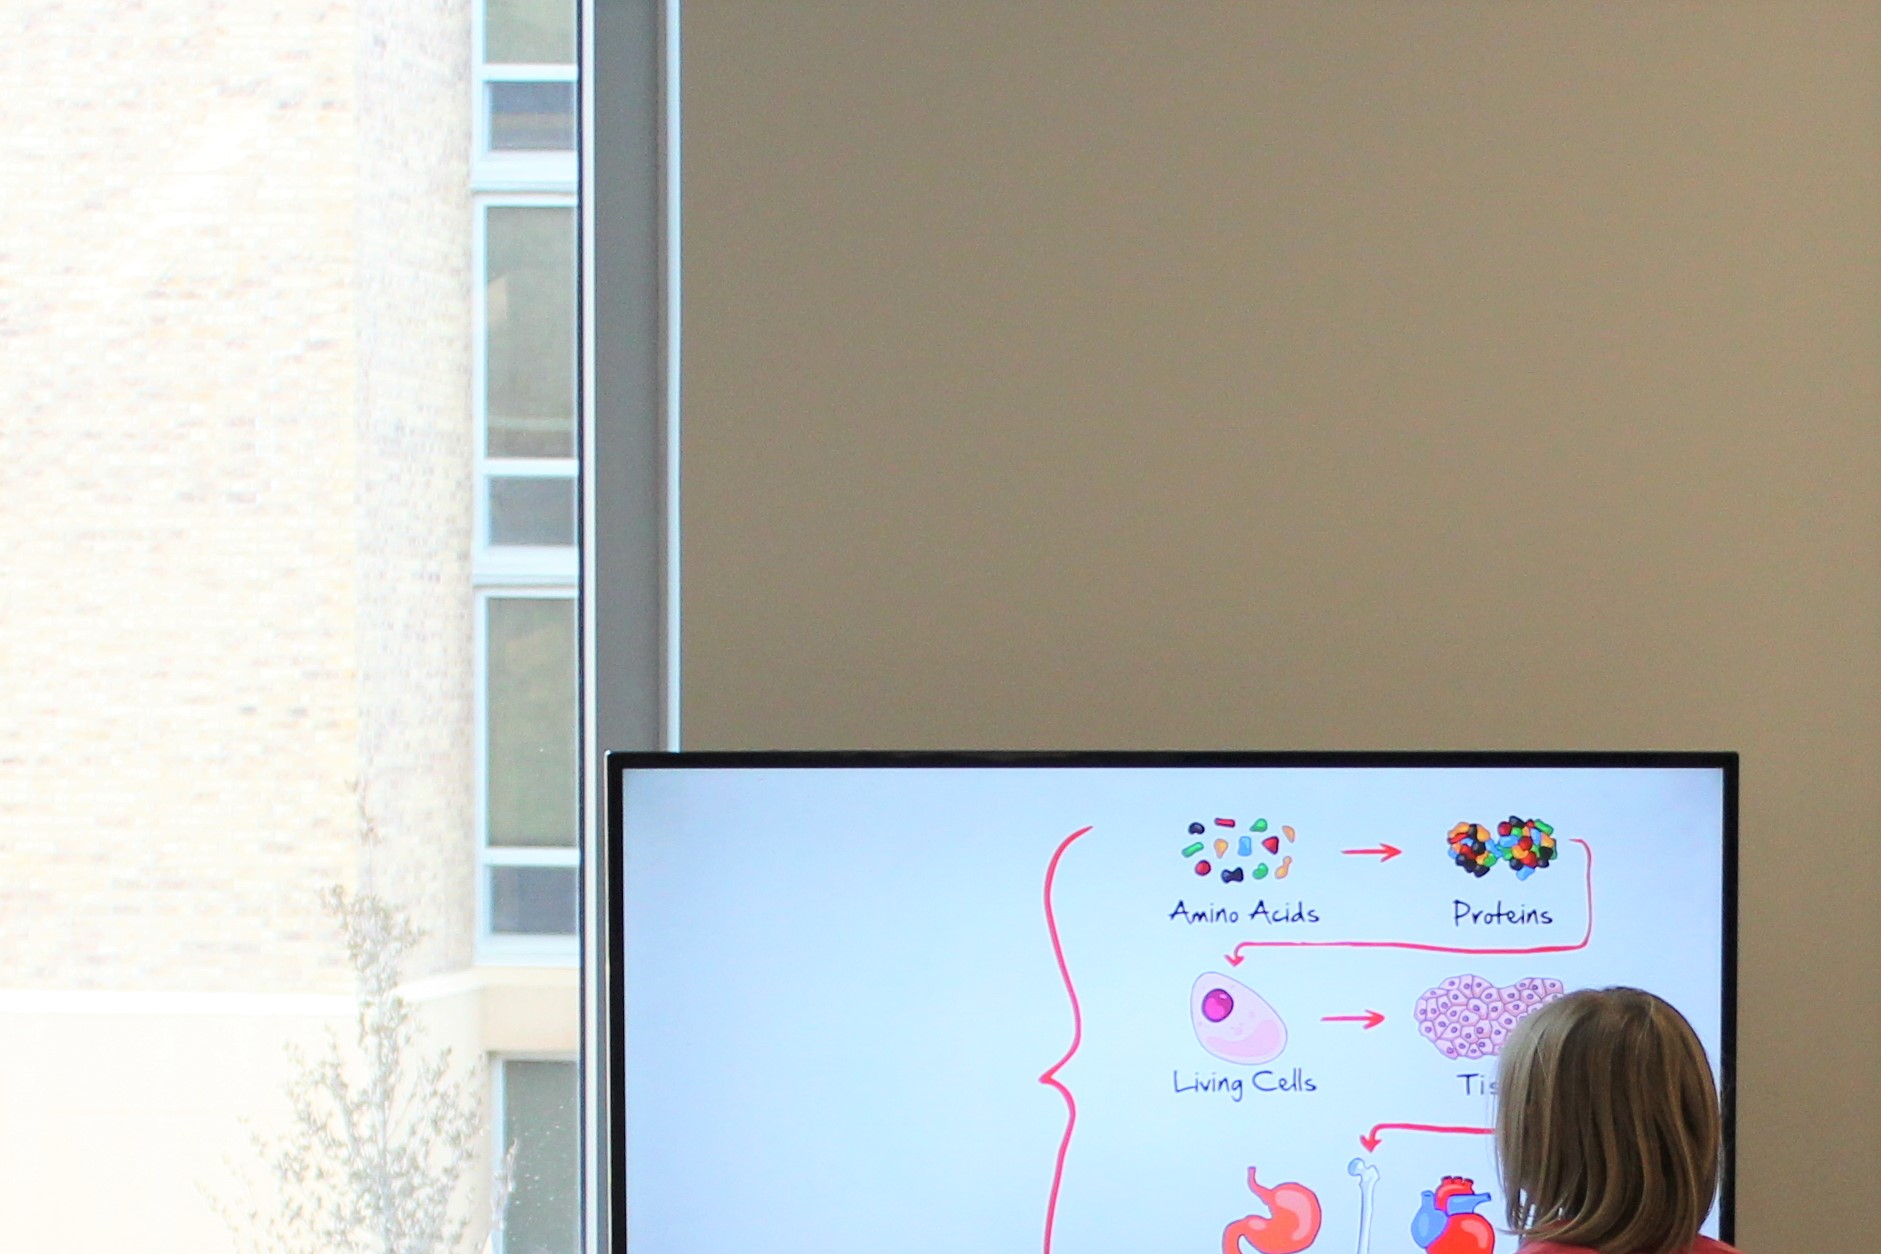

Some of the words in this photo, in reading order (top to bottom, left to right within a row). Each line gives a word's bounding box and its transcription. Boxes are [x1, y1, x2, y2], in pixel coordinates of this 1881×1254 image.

[1168, 899, 1238, 924] Amino
[1248, 899, 1320, 924] Acids
[1453, 900, 1553, 927] Proteins
[1173, 1070, 1243, 1102] Living
[1252, 1068, 1317, 1092] Cells
